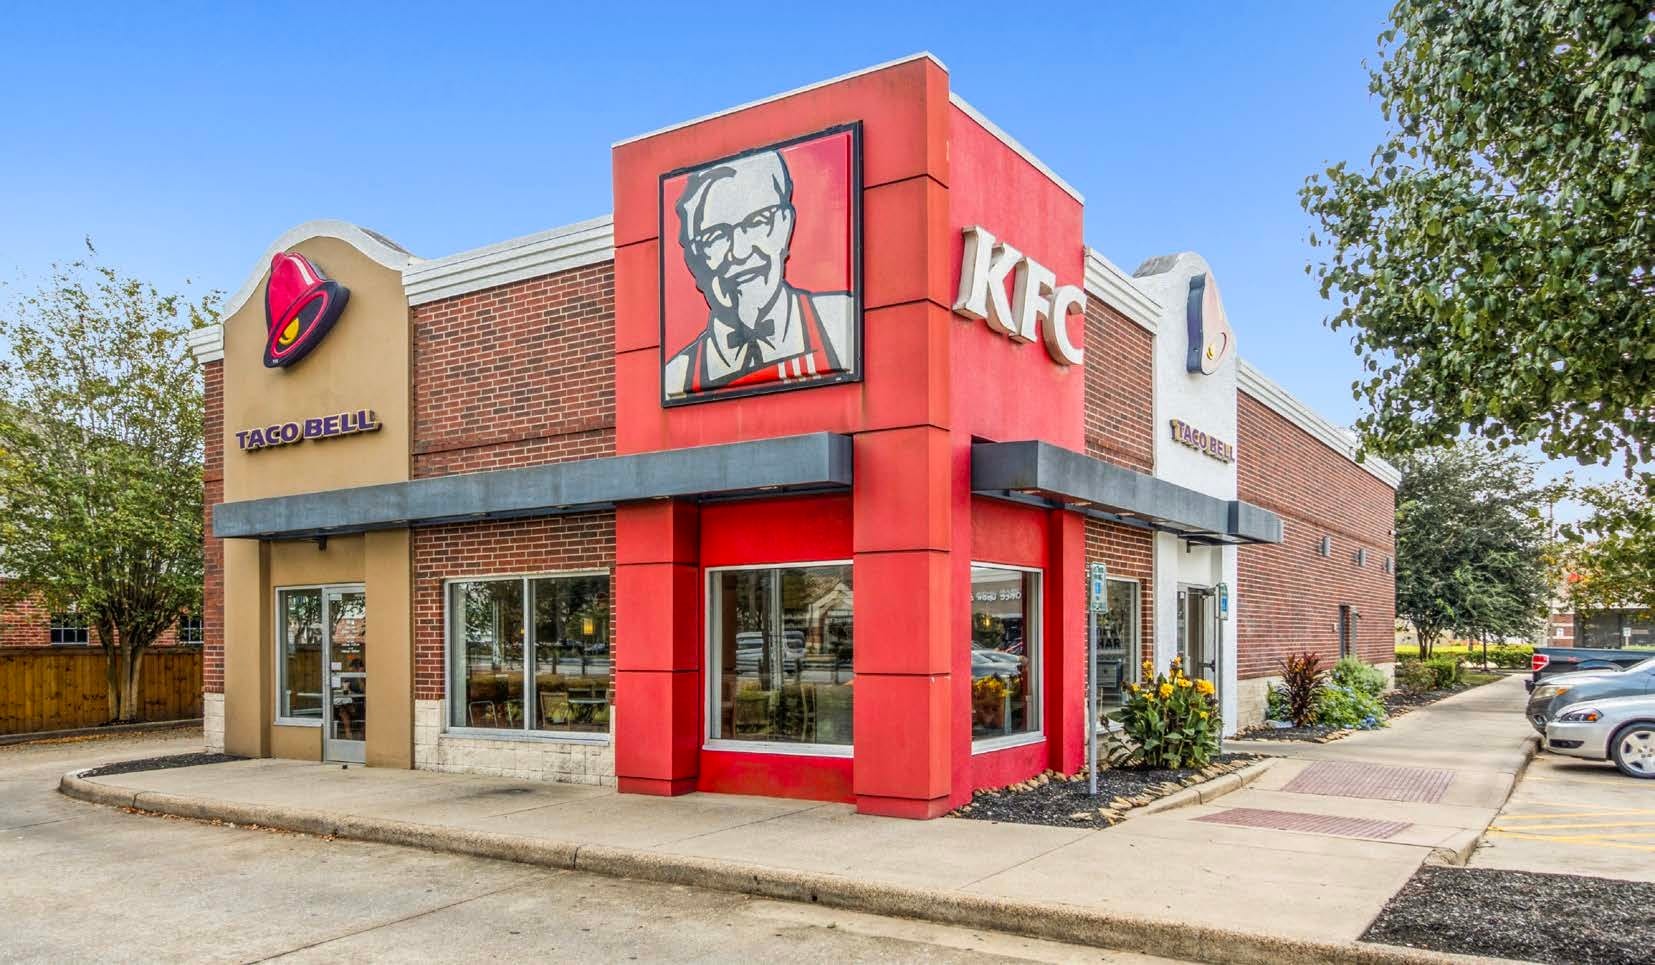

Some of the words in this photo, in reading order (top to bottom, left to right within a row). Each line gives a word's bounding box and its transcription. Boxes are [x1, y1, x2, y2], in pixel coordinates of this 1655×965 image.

[953, 224, 1087, 366] KFC
[235, 422, 300, 451] TACO
[303, 408, 379, 439] BELL
[1171, 417, 1207, 450] TACO
[1207, 435, 1235, 463] BELL
